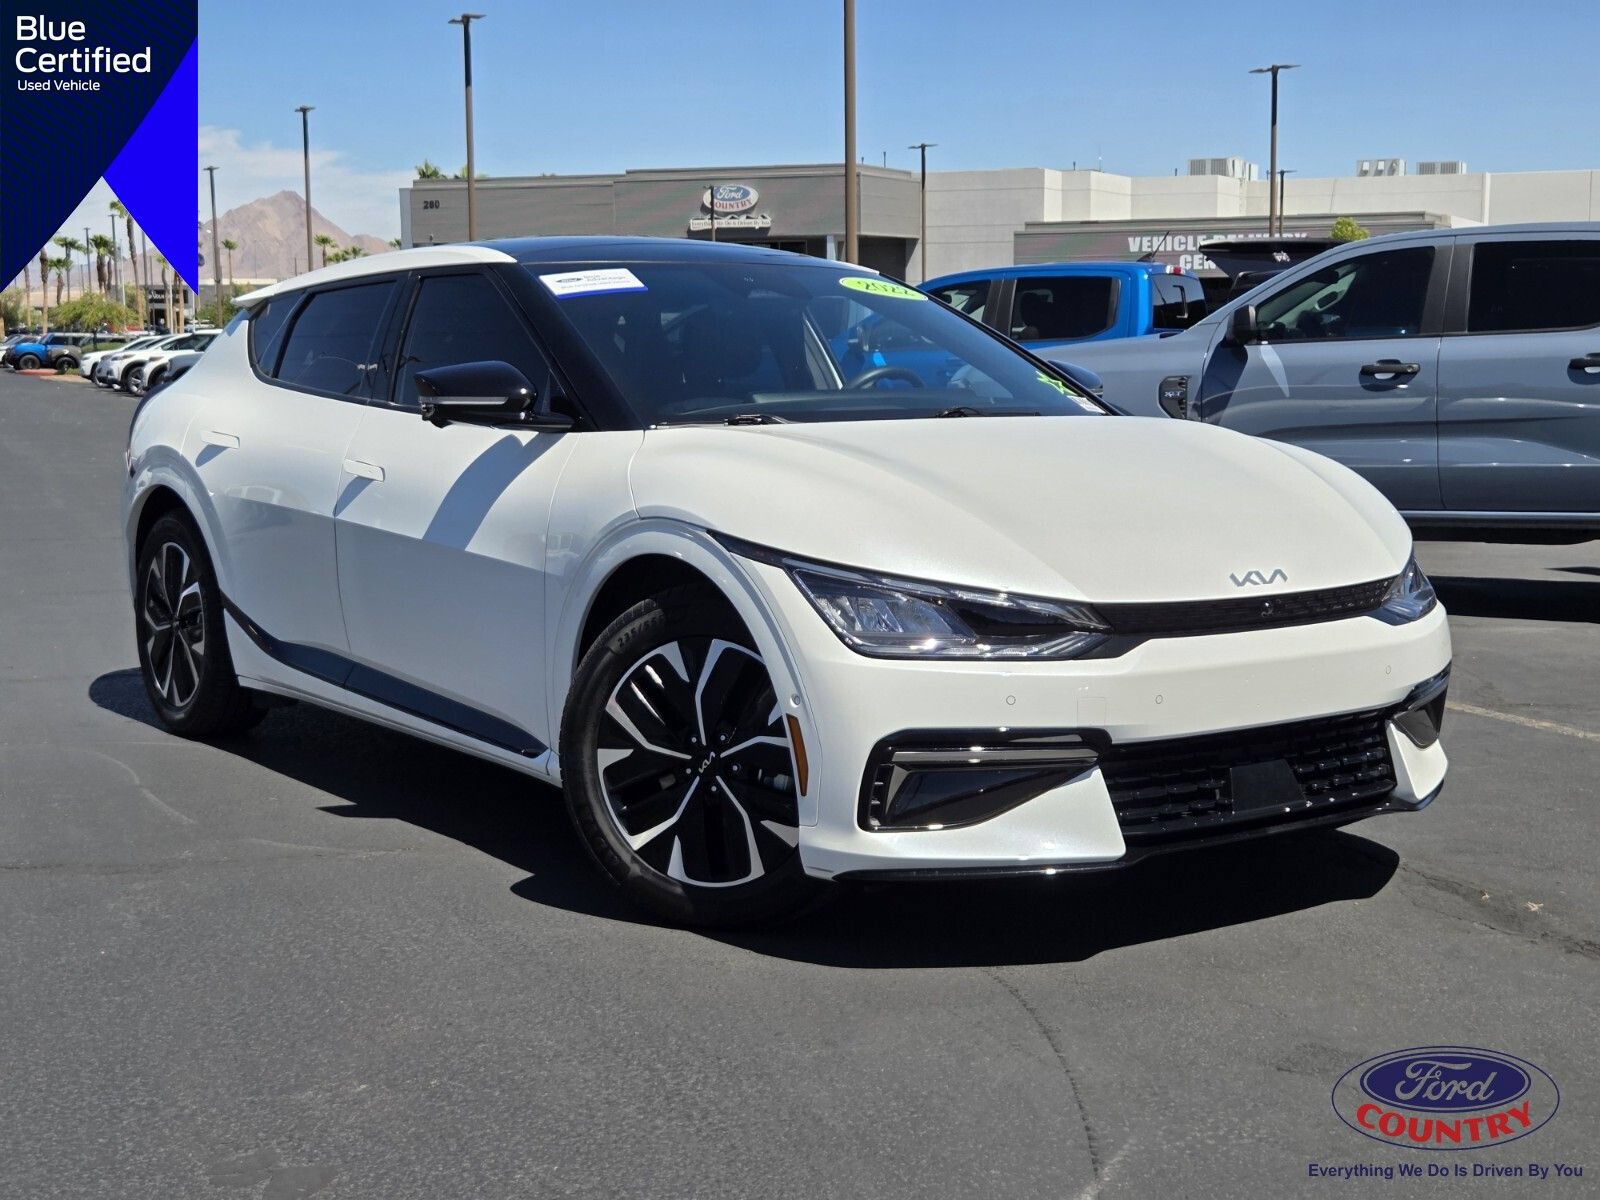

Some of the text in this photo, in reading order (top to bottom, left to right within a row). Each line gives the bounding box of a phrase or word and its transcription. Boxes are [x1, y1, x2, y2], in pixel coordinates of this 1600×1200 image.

[717, 185, 744, 199] Ford
[714, 200, 753, 210] OUNTRY
[1229, 568, 1288, 587] KIA
